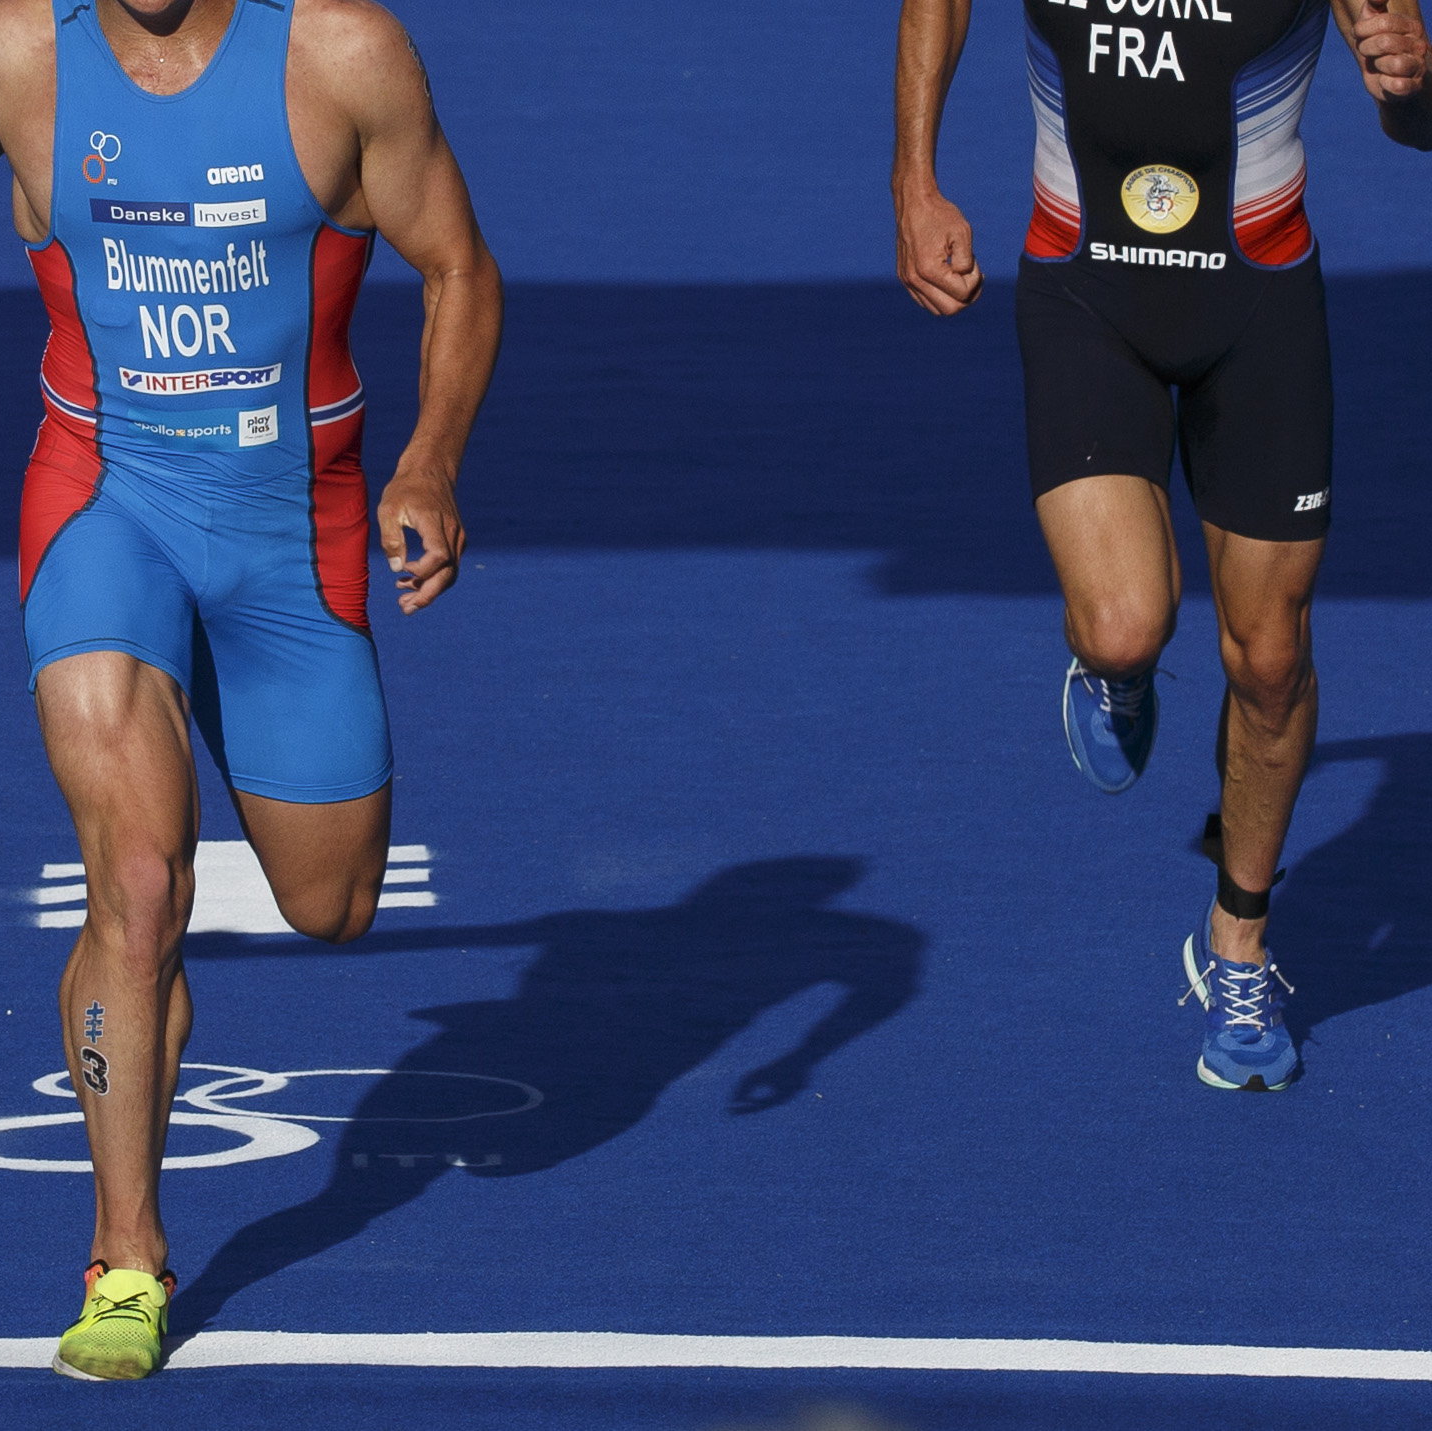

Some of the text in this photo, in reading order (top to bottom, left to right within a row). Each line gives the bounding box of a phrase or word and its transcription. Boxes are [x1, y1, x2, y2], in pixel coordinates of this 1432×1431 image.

[1087, 24, 1185, 82] FRA
[207, 164, 264, 185] arena
[1144, 167, 1157, 175] DE
[1158, 167, 1197, 194] CHAMPIONS
[110, 206, 260, 223] Danske Invest
[103, 237, 270, 295] Blummenfelt
[1090, 242, 1227, 270] SHIMANO
[139, 304, 237, 359] NOR
[145, 368, 275, 392] INTERSPORT
[186, 424, 232, 439] sports
[247, 415, 271, 429] play
